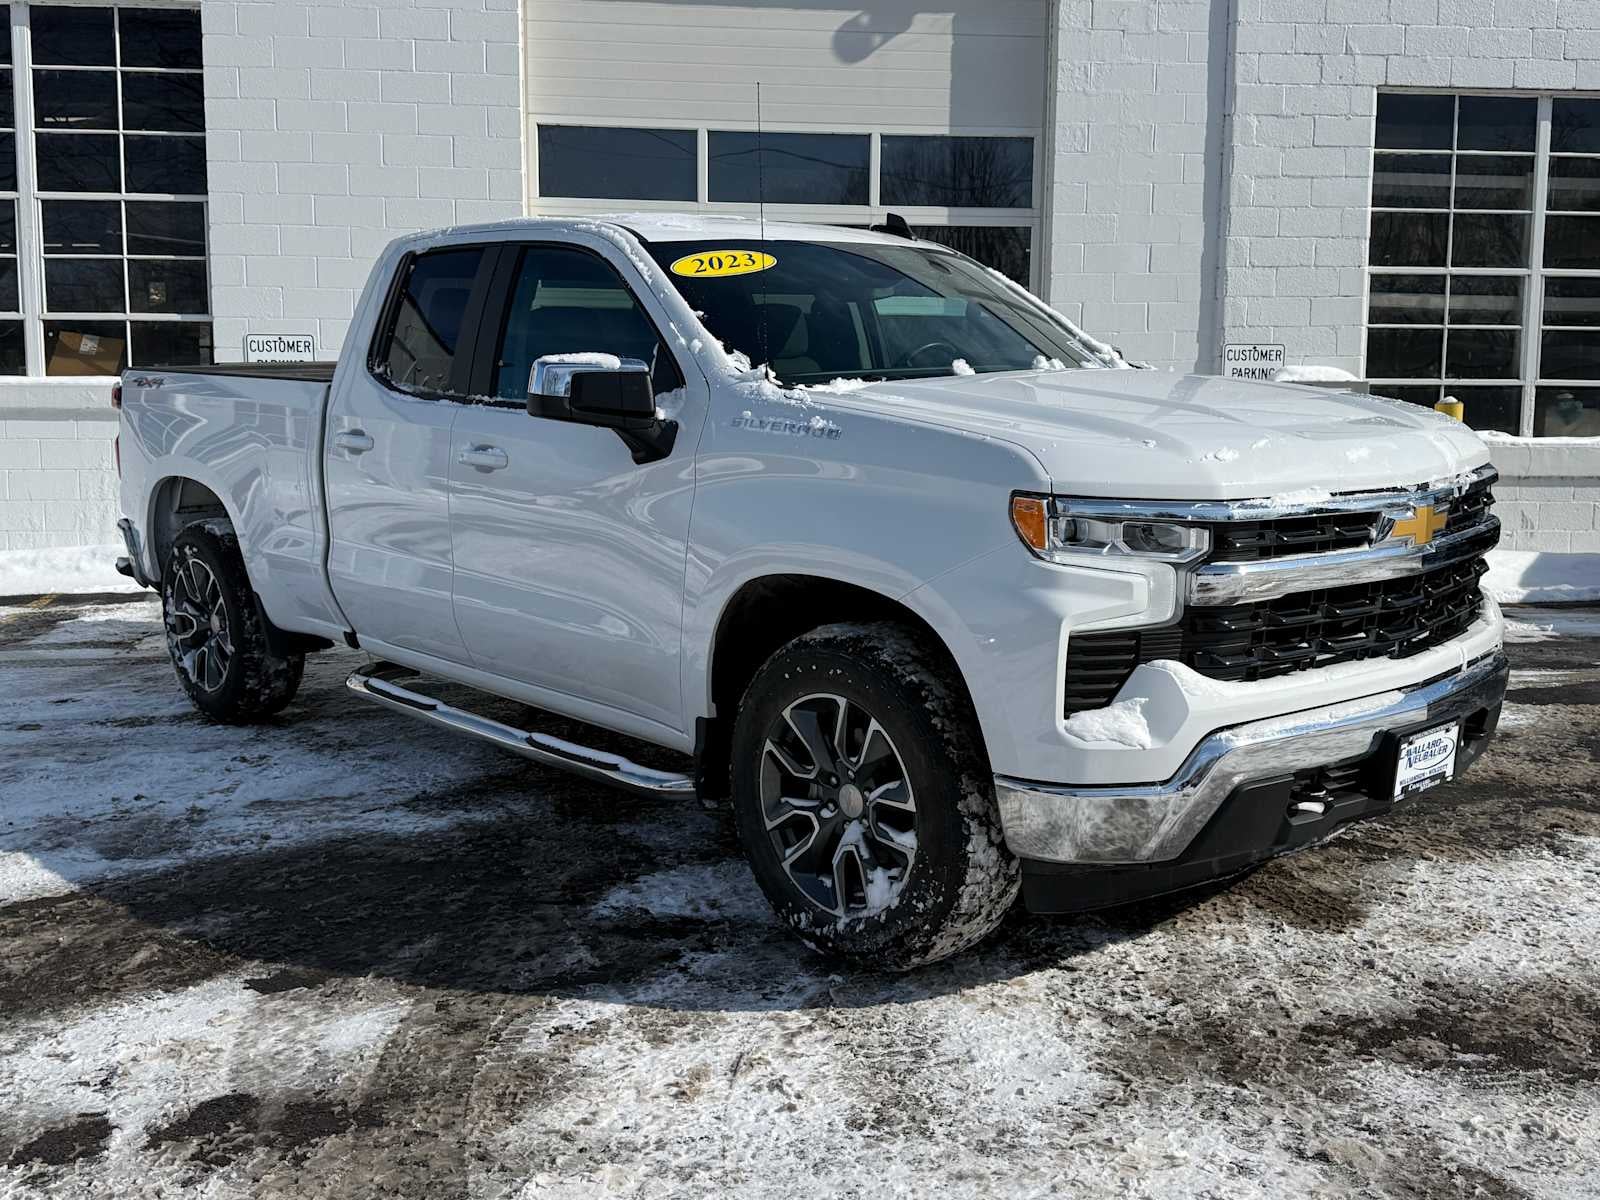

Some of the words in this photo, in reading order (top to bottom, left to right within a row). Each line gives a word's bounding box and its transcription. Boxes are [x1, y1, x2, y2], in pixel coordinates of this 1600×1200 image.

[691, 253, 756, 273] 2023
[249, 339, 311, 353] CUSTOMER
[1226, 348, 1283, 362] CUSTOMER
